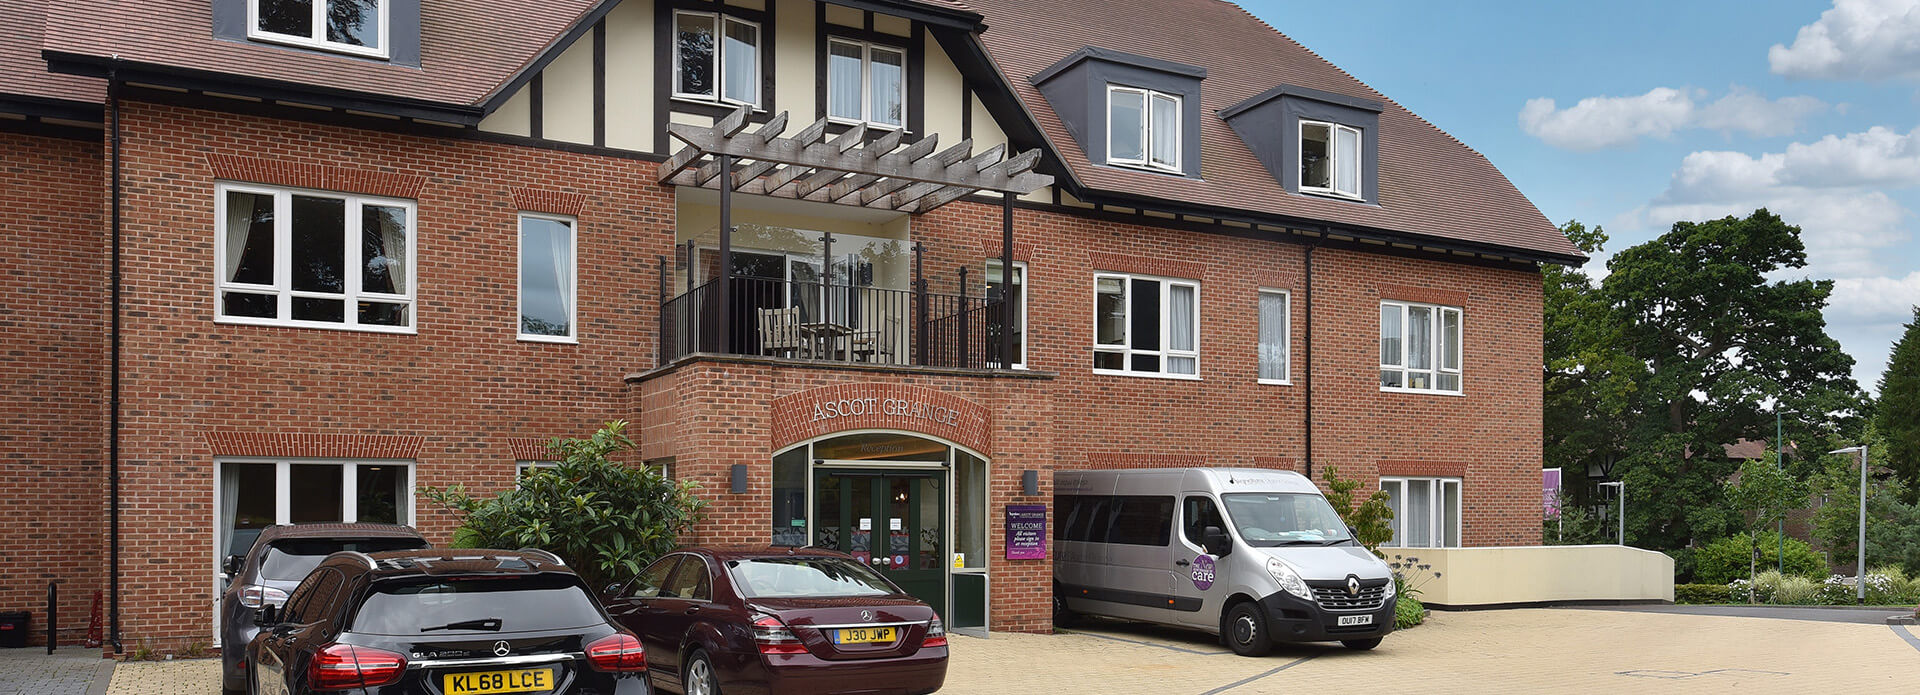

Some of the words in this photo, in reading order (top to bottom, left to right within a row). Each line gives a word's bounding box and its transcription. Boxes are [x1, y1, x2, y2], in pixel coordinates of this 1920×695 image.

[812, 398, 877, 422] ASCOT
[882, 398, 960, 427] GRANGE
[1191, 571, 1215, 583] care
[846, 630, 867, 641] J30
[870, 629, 890, 640] JWP
[412, 651, 437, 659] GLA
[453, 673, 504, 693] KL68
[509, 671, 545, 689] LCE
